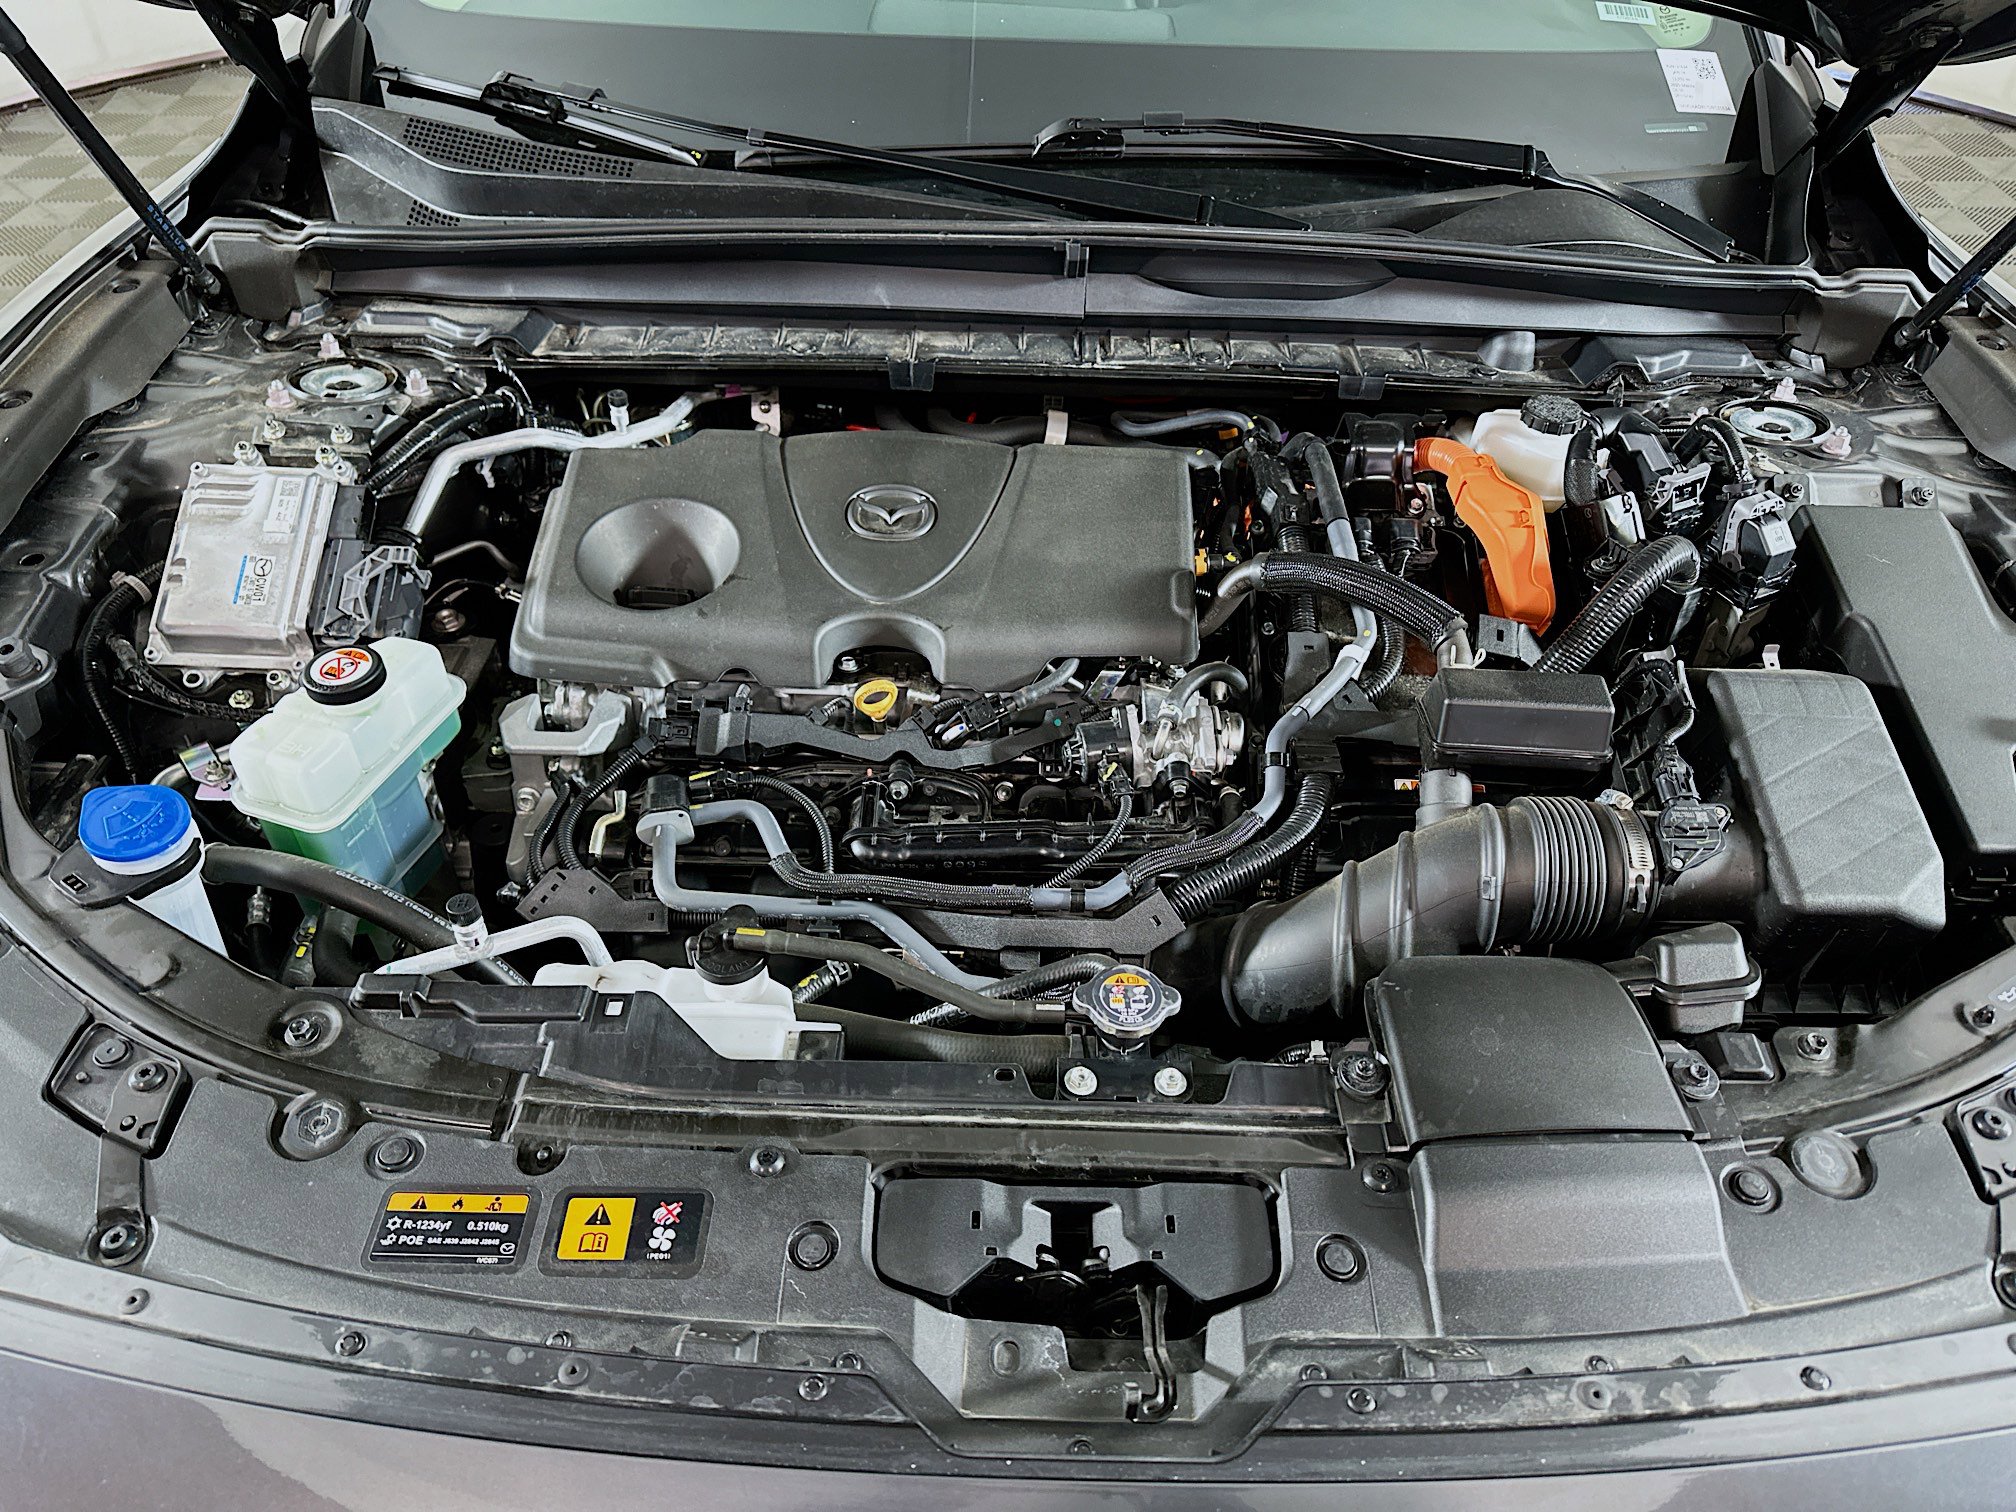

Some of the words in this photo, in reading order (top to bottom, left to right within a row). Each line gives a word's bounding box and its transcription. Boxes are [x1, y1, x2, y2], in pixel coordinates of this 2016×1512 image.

[147, 204, 186, 252] STABILUS
[252, 577, 267, 602] CW01
[403, 1220, 452, 1233] R-1234yf
[467, 1220, 509, 1233] 0.510kg
[398, 1235, 425, 1246] POE
